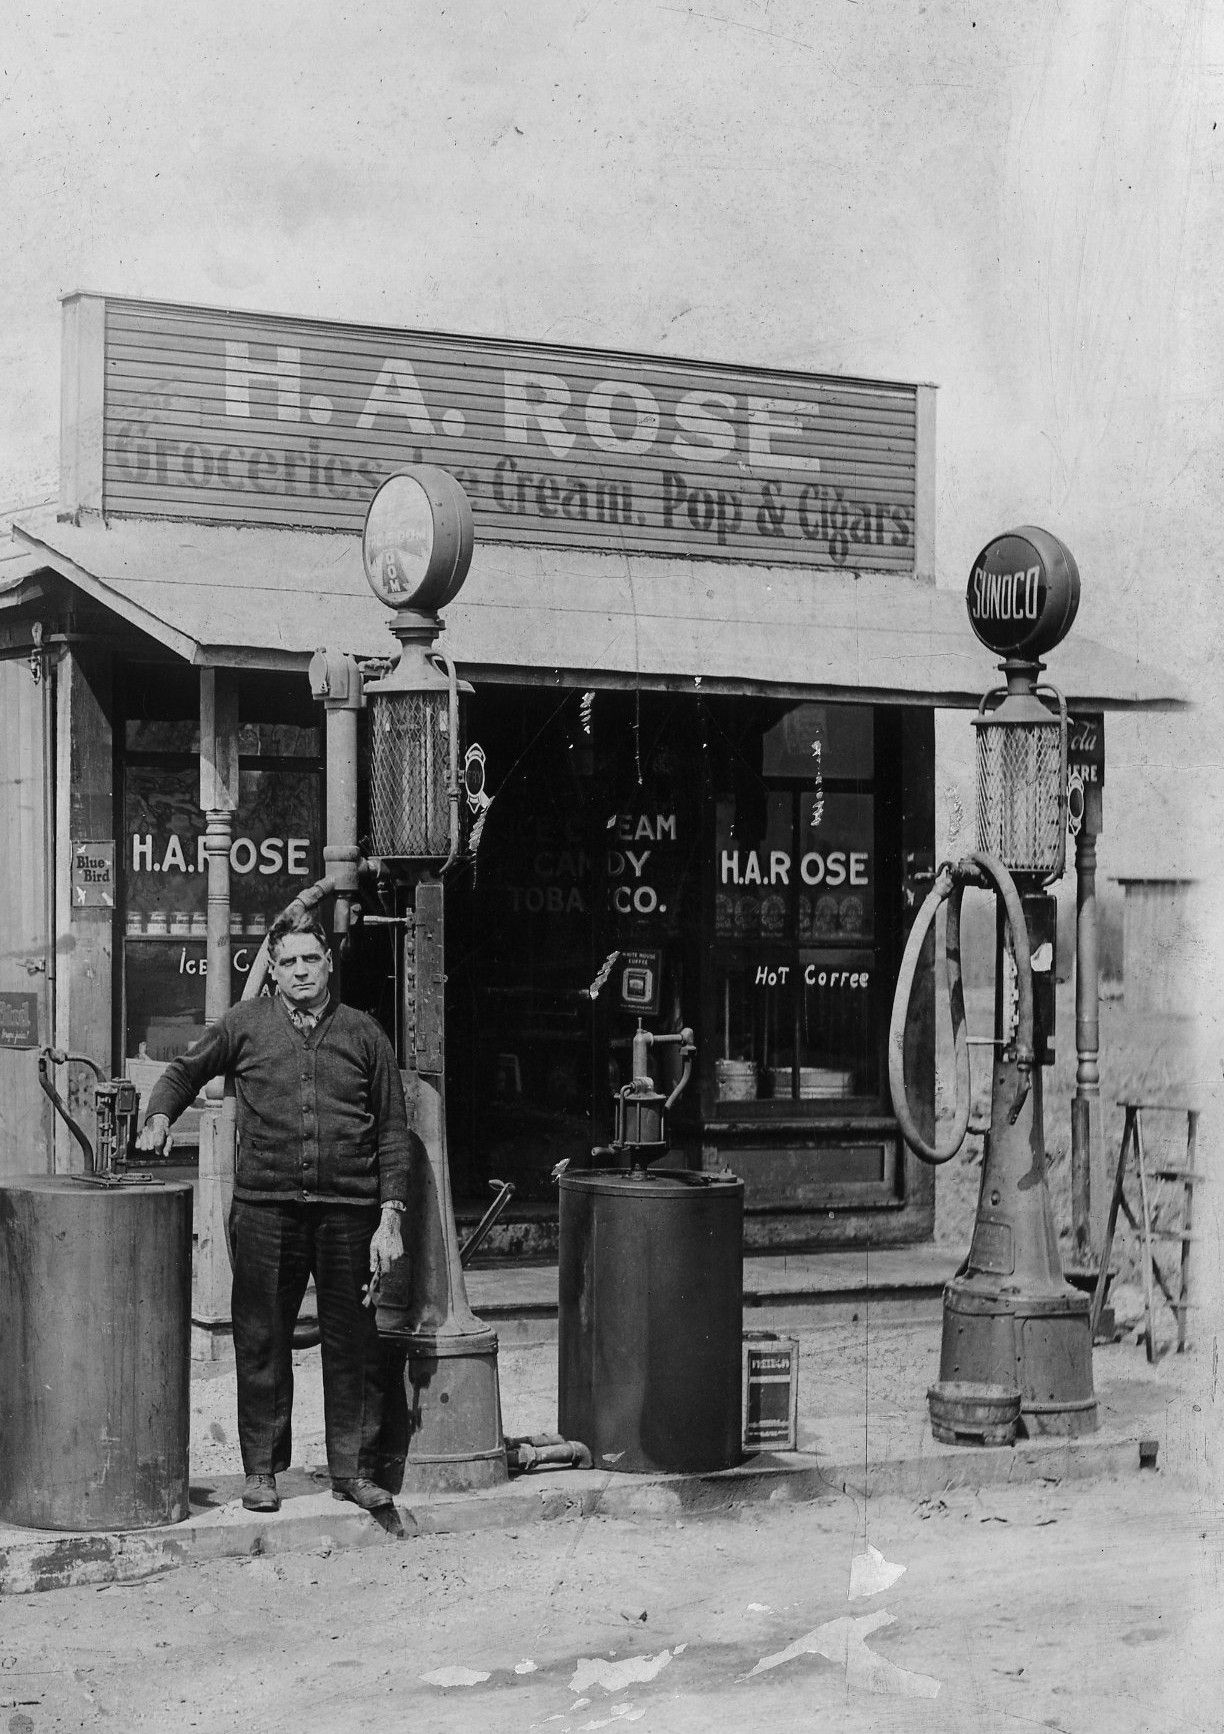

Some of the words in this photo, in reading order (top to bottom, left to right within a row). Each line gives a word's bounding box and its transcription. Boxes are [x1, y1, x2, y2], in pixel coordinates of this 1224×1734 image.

[503, 369, 821, 473] ROSE
[660, 471, 744, 546] Pop
[756, 480, 786, 538] &
[798, 483, 913, 567] Cigars
[972, 565, 1040, 620] SUNOCO
[1071, 721, 1096, 751] ola
[76, 855, 105, 869] Blue
[83, 869, 110, 882] Bird
[508, 886, 666, 914] TOBACO.
